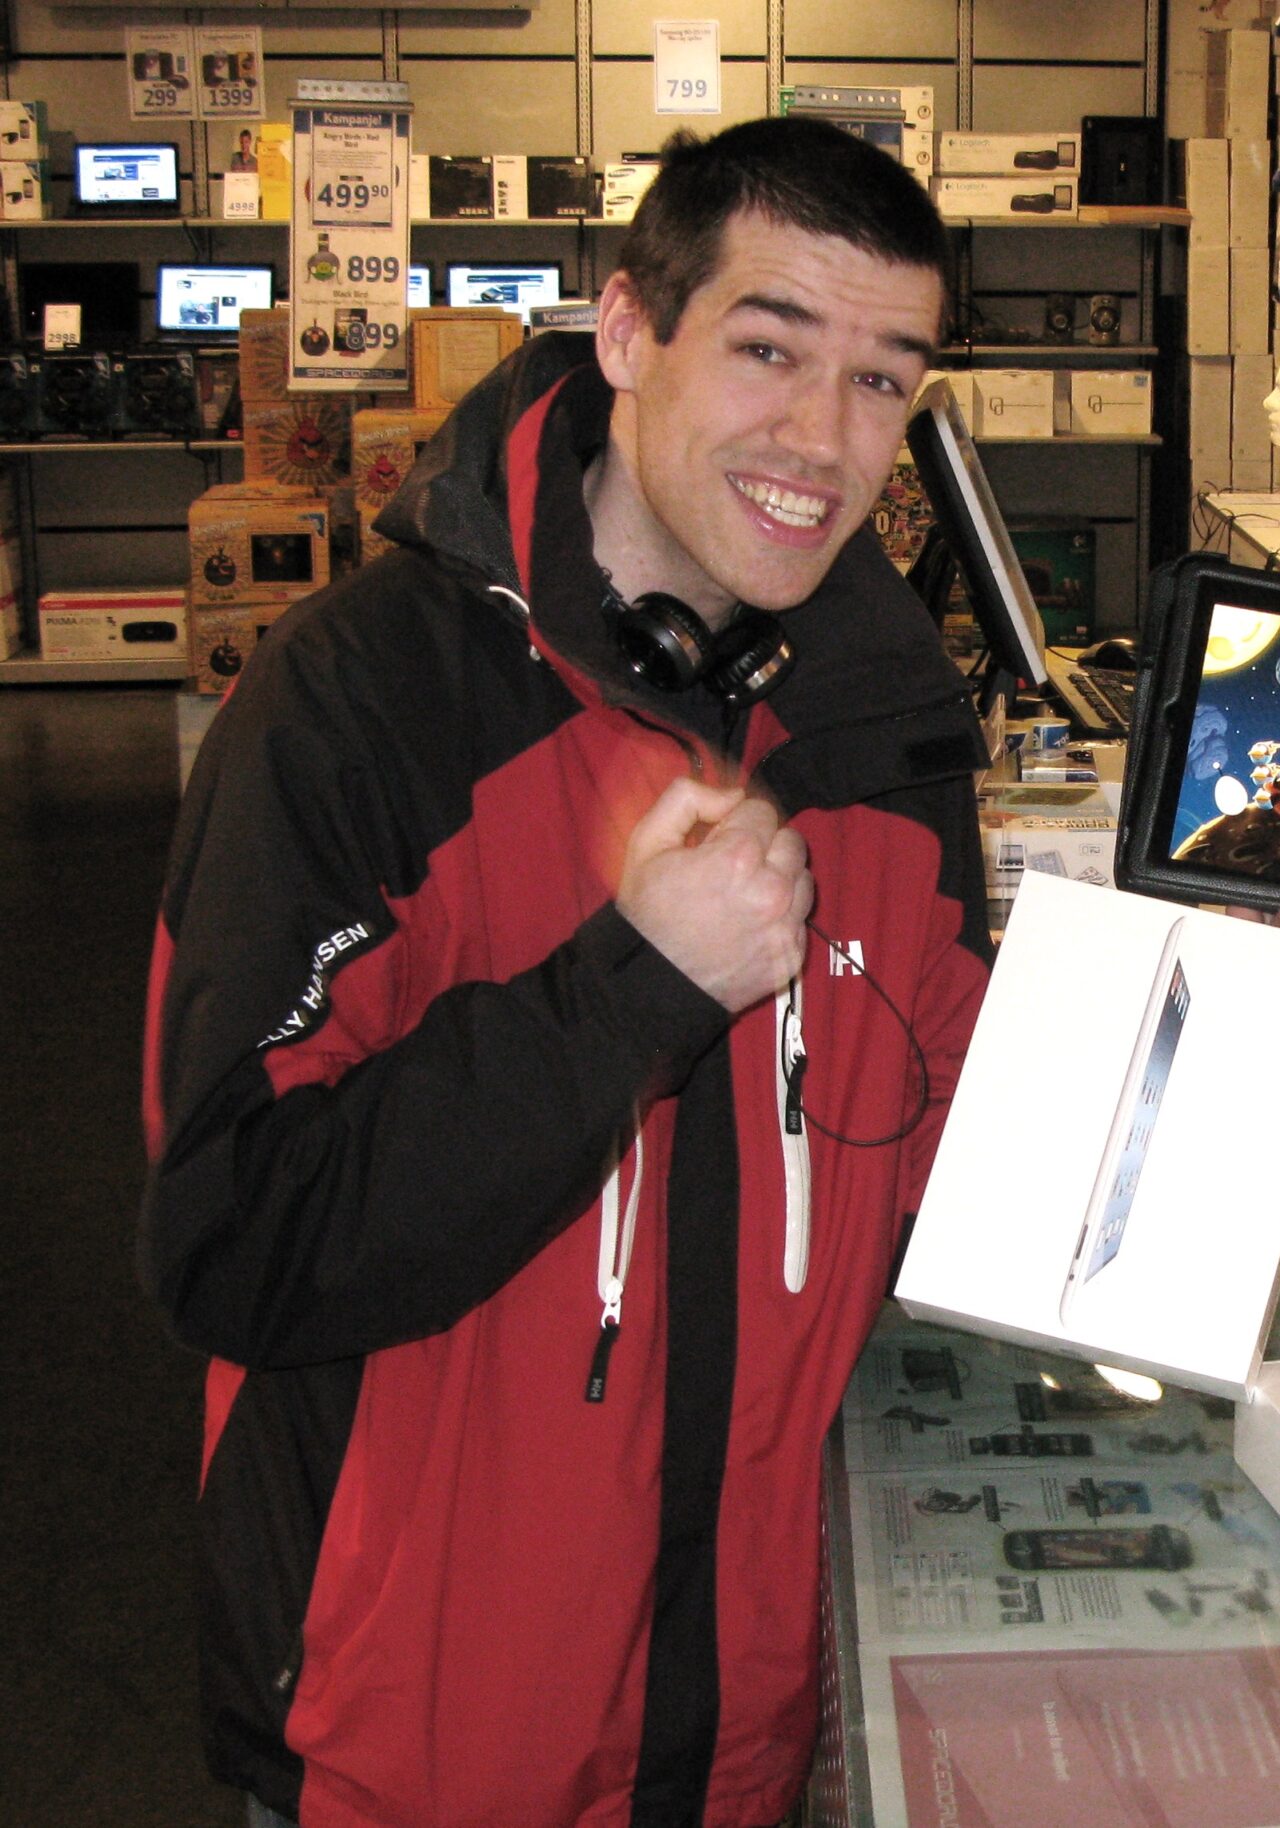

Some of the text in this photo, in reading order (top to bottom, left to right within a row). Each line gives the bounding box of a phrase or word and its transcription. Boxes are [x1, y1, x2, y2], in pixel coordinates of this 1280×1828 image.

[144, 89, 177, 106] 299
[210, 89, 254, 106] 1399
[667, 79, 707, 98] 799
[323, 112, 382, 127] Kampanje!
[317, 183, 389, 208] 499 90
[347, 255, 400, 283] 899
[333, 290, 351, 298] Black
[346, 322, 400, 349] 899
[306, 368, 394, 378] SPACEWORLD
[302, 923, 369, 1010] HANSEN
